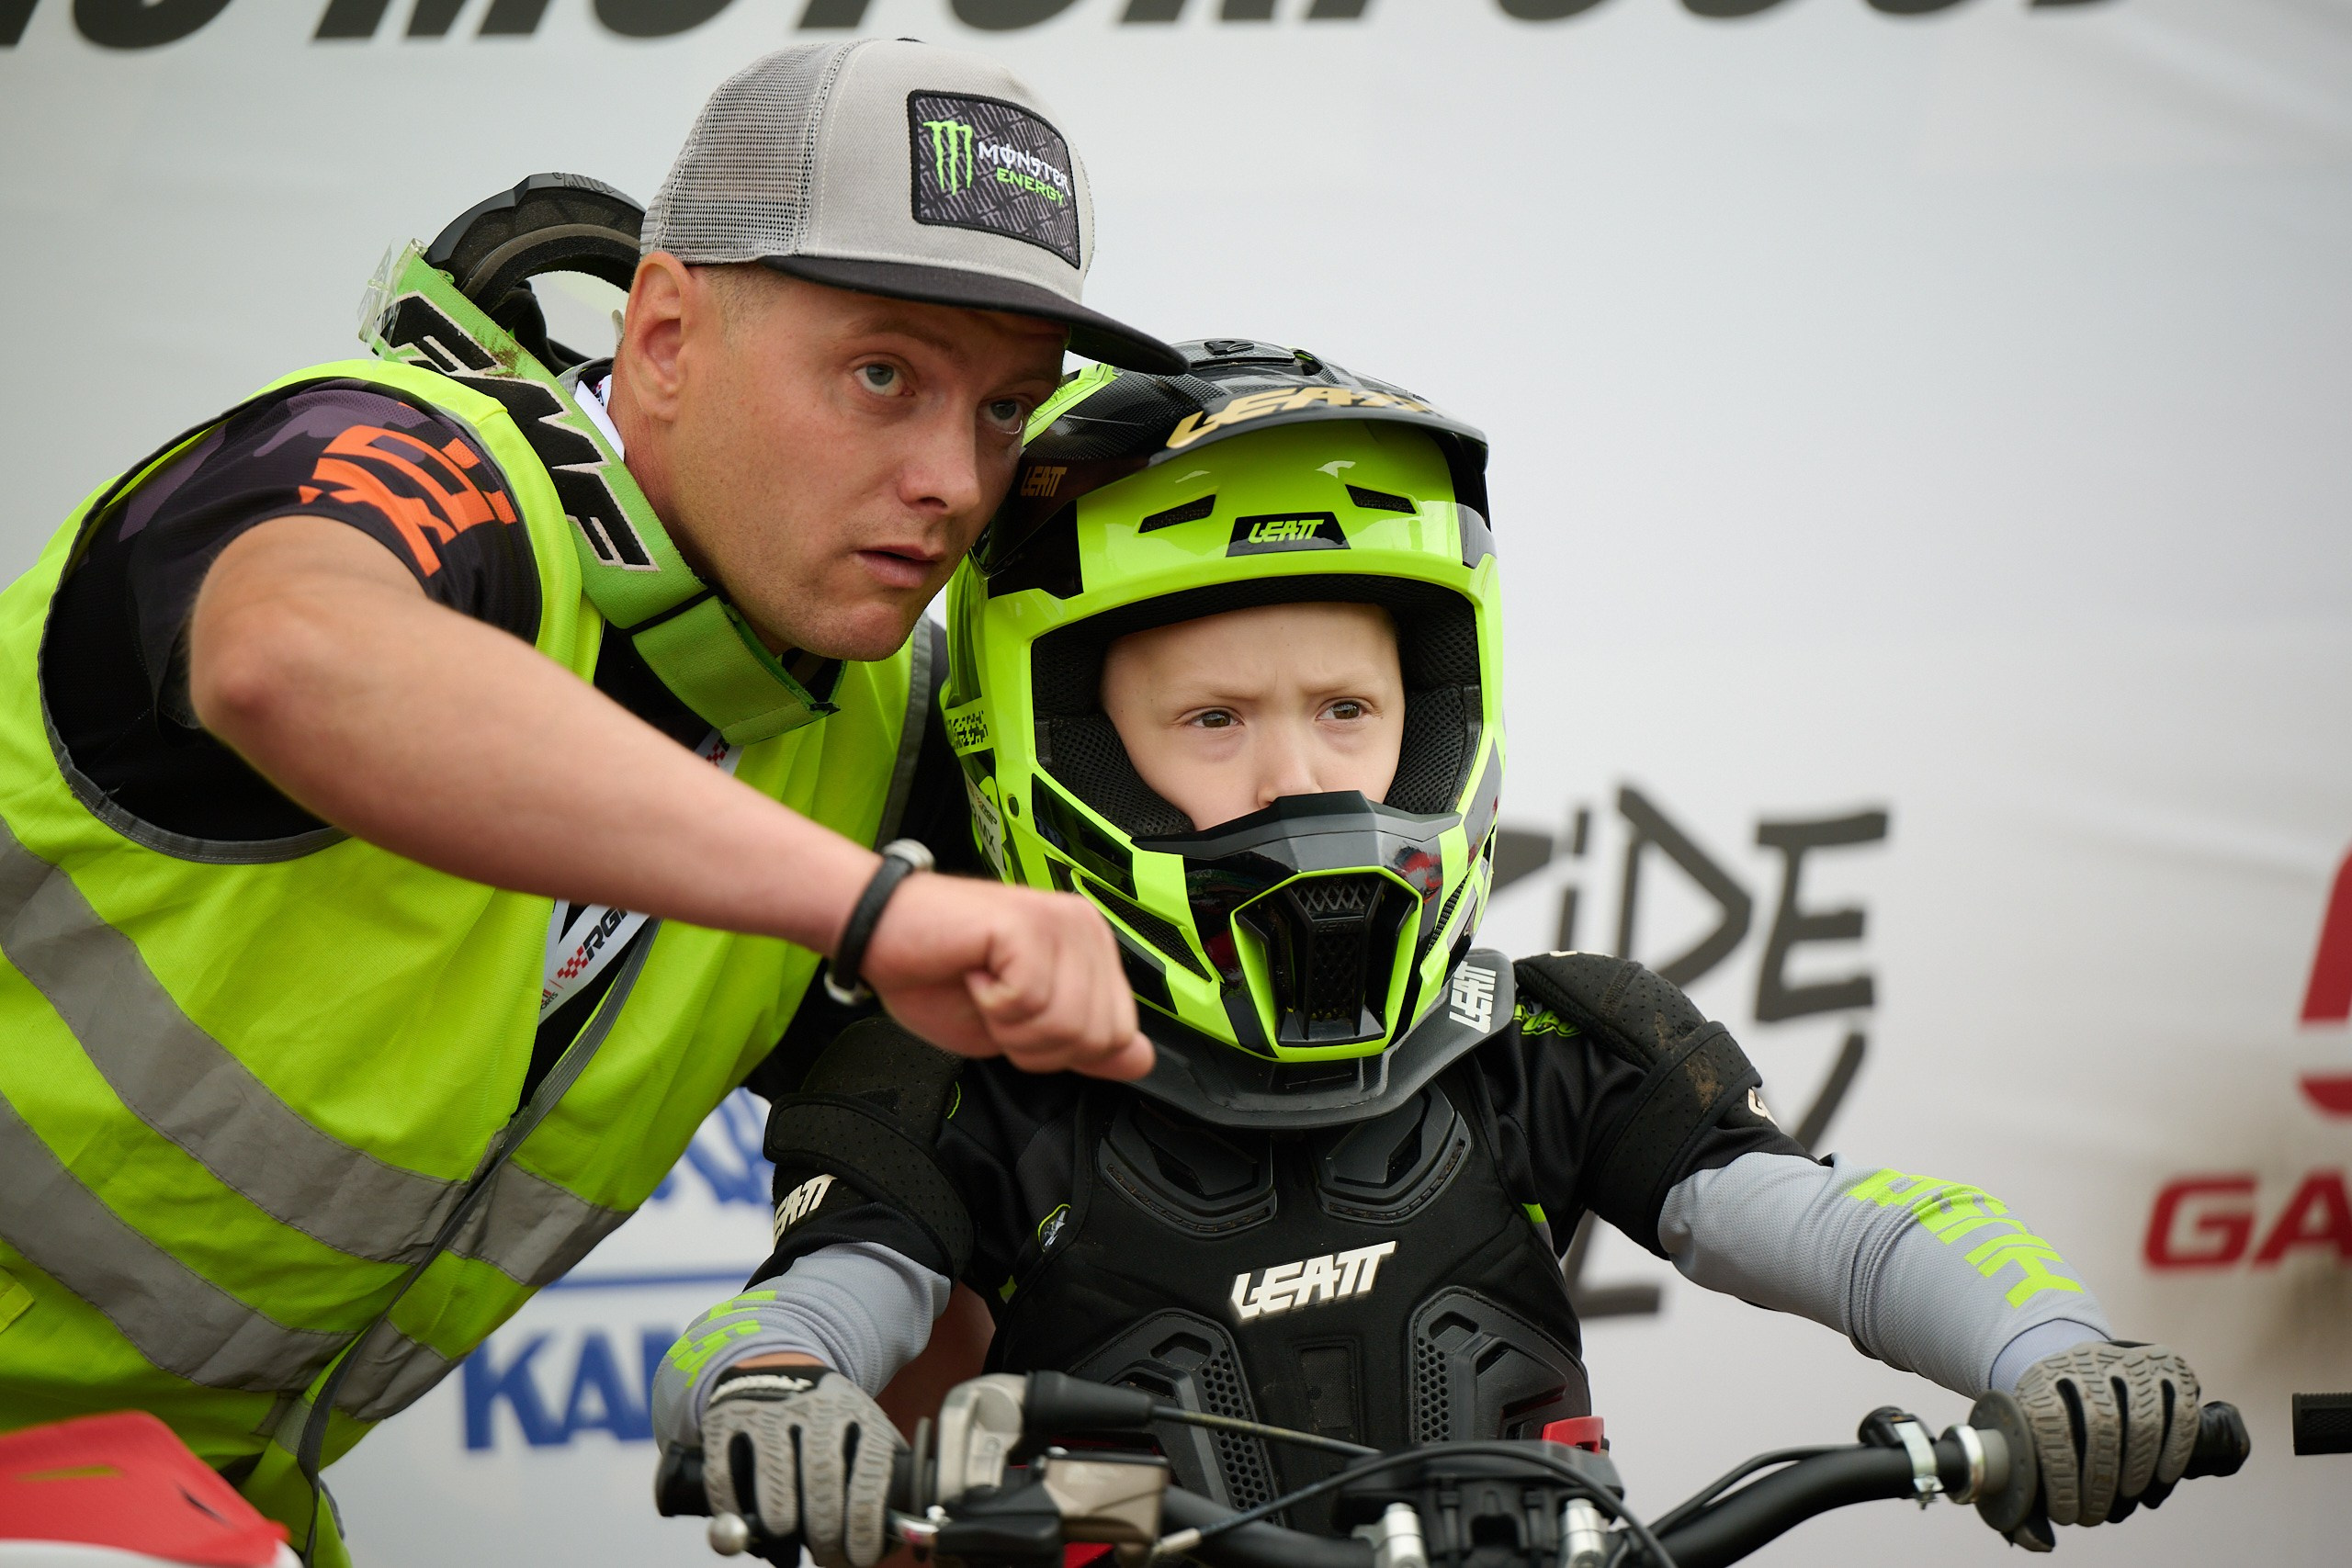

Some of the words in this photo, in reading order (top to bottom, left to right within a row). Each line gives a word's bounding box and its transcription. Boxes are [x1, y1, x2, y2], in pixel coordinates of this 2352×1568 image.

[978, 141, 1071, 196] MONSTER
[997, 167, 1064, 205] ENERGY
[1021, 466, 1068, 497] LEATT
[1248, 519, 1324, 544] LEATT
[1449, 960, 1497, 1034] LEATT
[774, 1173, 838, 1254] EATT
[1231, 1240, 1396, 1321] LEATT
[463, 1323, 700, 1451] KA
